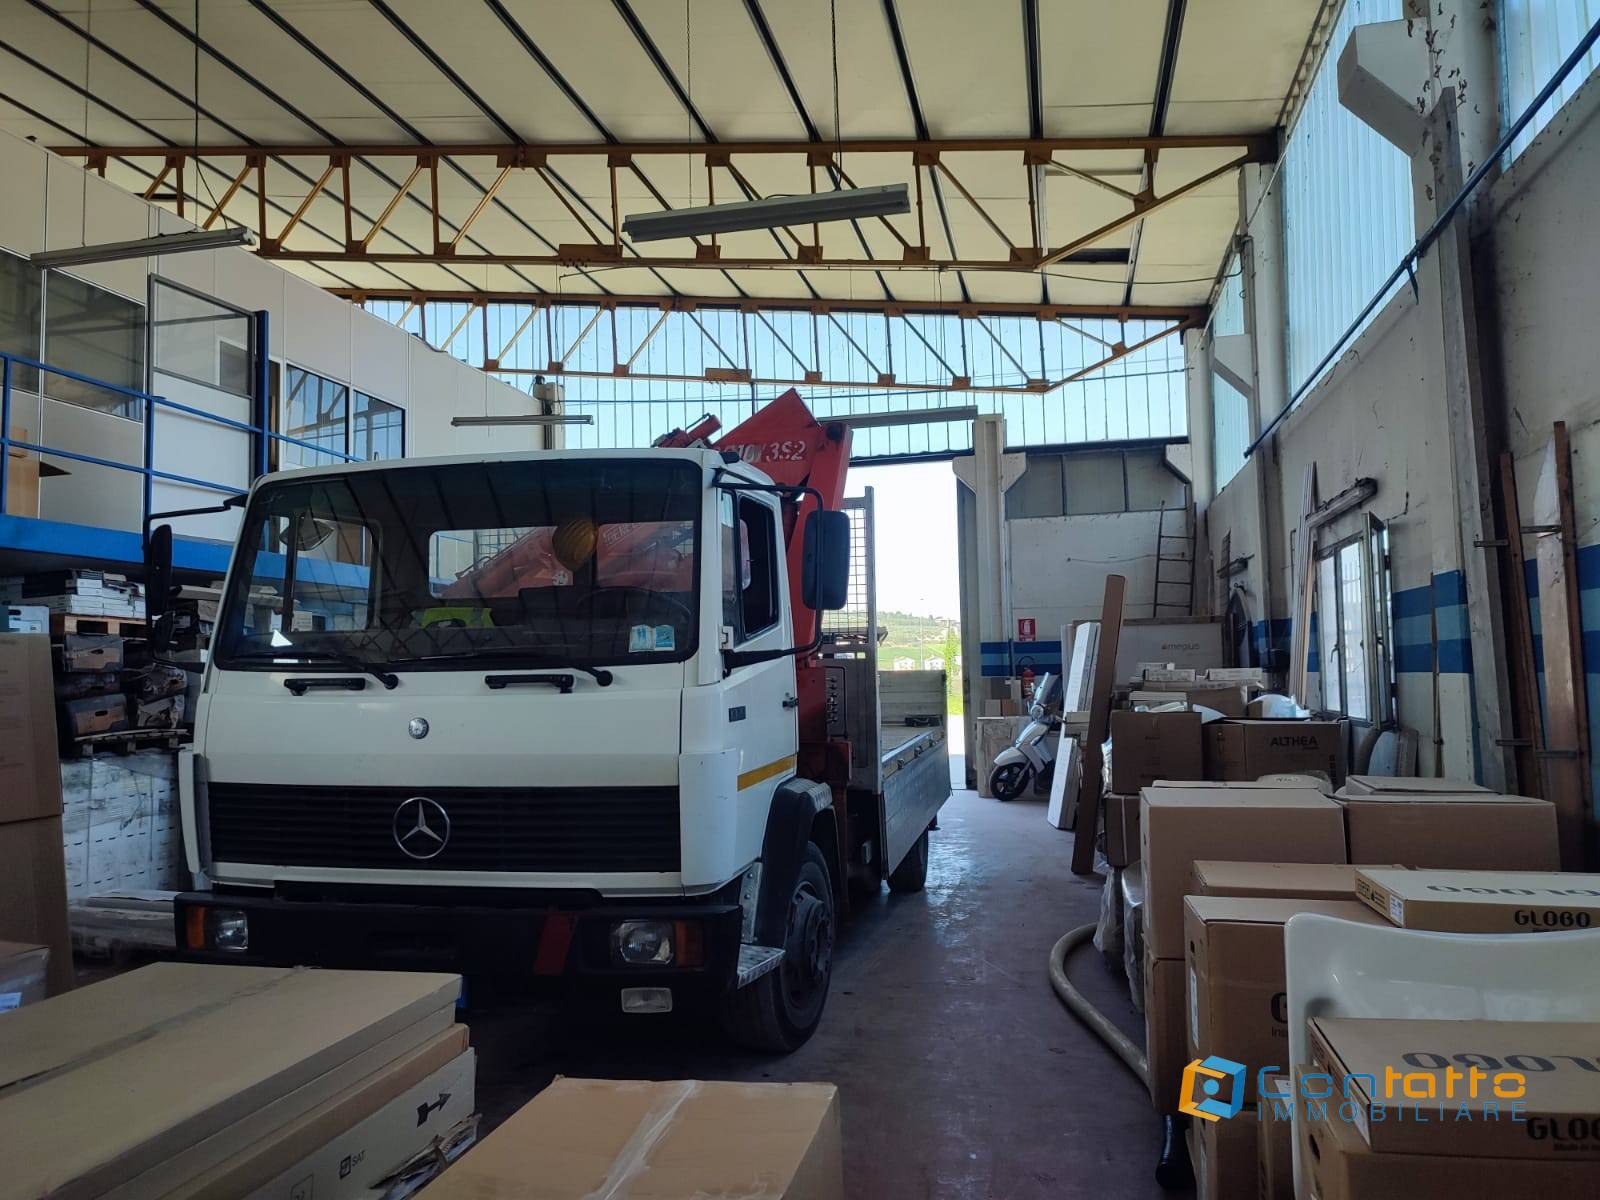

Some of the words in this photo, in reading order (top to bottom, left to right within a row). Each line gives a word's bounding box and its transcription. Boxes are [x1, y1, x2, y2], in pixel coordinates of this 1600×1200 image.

[1270, 735, 1319, 747] ALTHEA
[1514, 909, 1591, 928] GLOBO
[1402, 1053, 1600, 1073] LOBO
